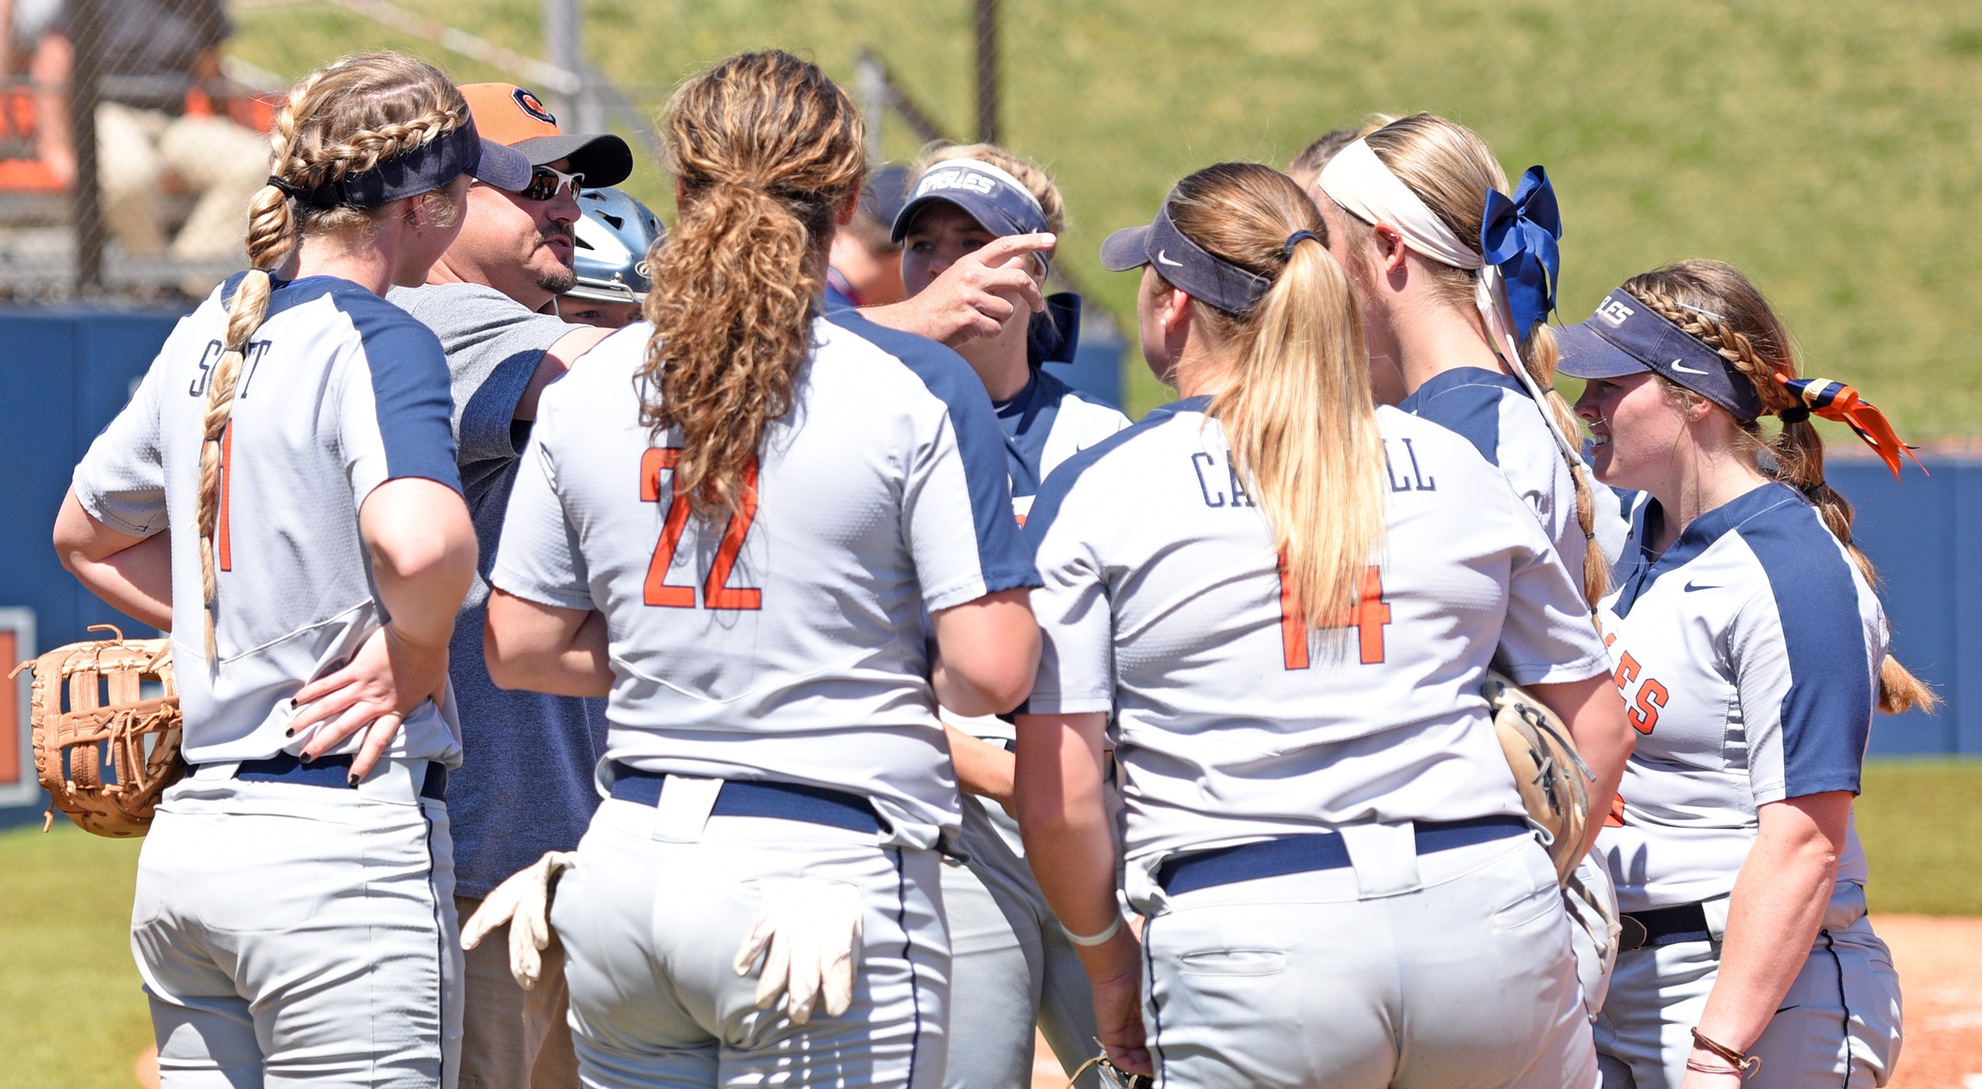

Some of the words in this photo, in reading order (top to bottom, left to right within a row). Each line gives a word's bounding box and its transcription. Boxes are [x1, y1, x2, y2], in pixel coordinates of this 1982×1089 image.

[916, 170, 996, 197] EAGLES
[640, 447, 762, 610] 22
[1277, 542, 1391, 671] 14
